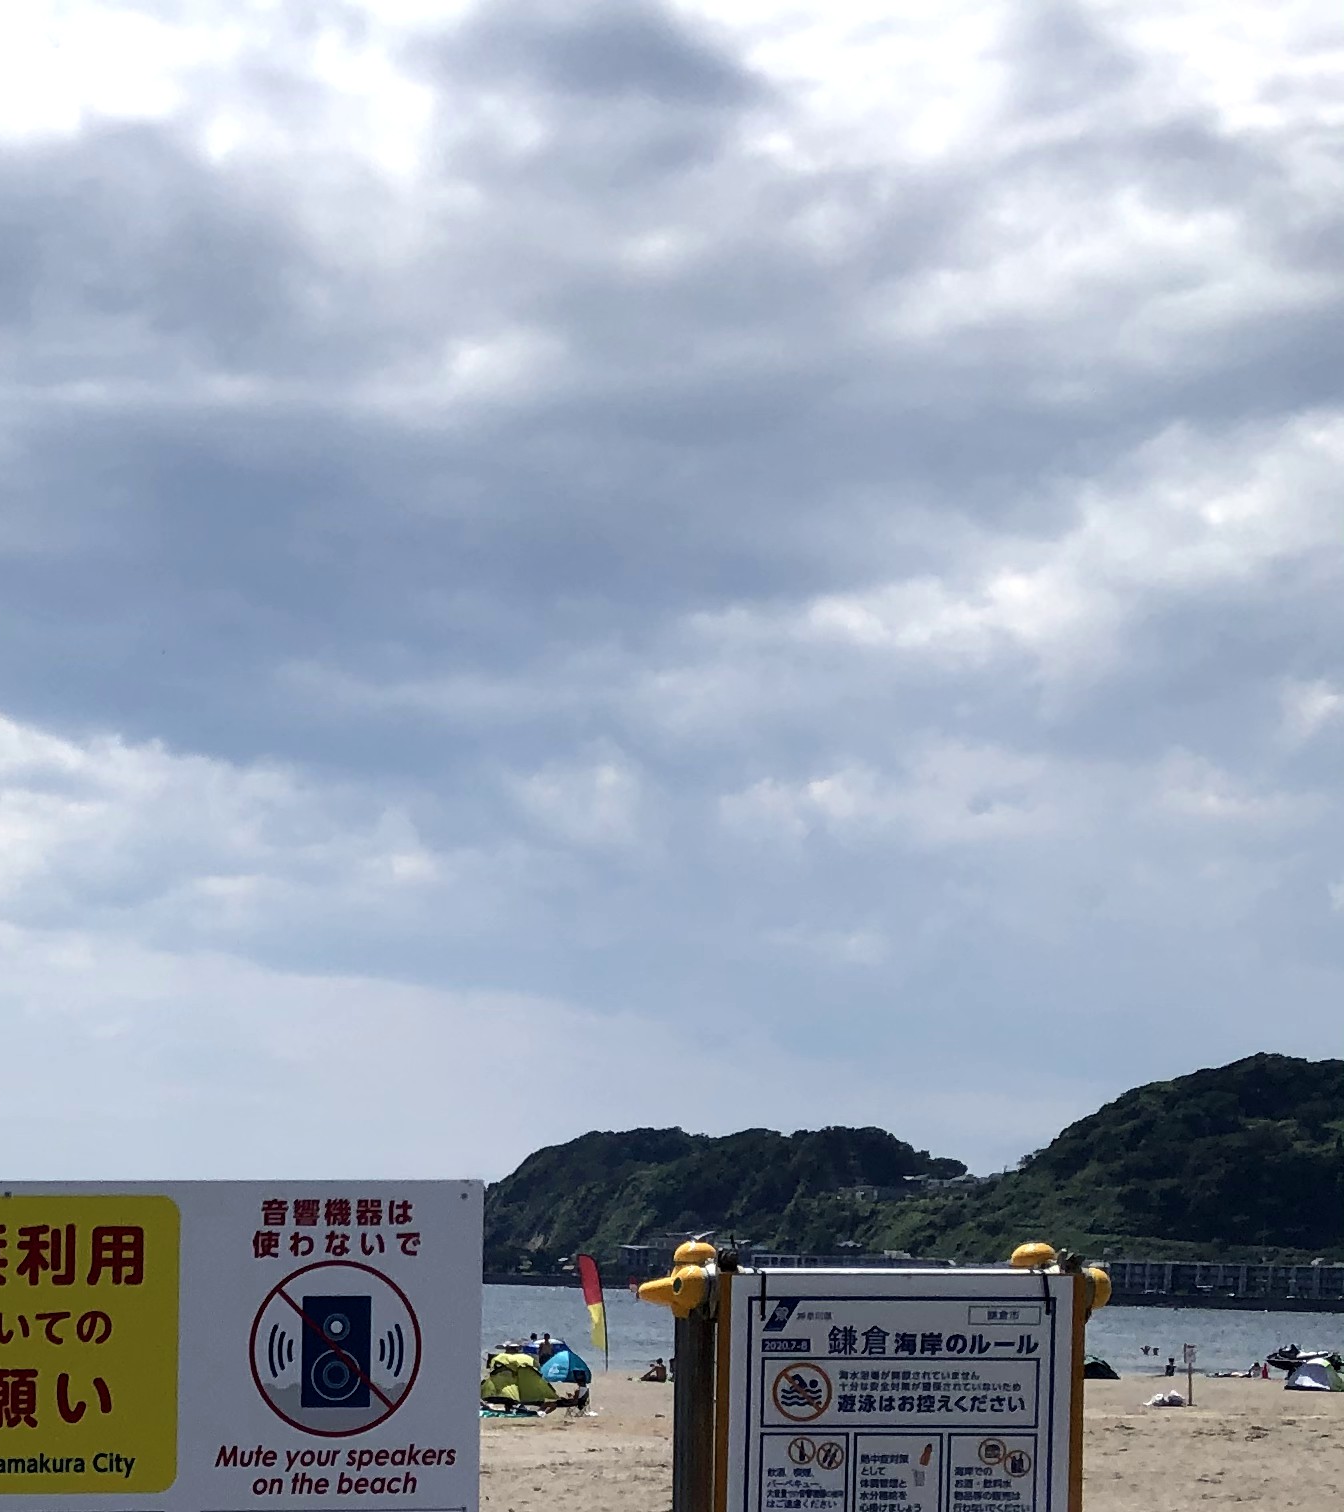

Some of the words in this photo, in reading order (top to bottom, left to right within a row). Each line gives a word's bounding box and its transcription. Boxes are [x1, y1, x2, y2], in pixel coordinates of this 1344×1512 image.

[261, 1199, 413, 1227] 音響機器は
[252, 1230, 422, 1259] 使わないで
[763, 1340, 809, 1352] 2020.7-8
[828, 1325, 1040, 1356] 鎌倉海岸のルール
[837, 1394, 1026, 1414] 遊泳はお控えください
[92, 1451, 136, 1479] City
[214, 1444, 278, 1469] Mute
[285, 1448, 342, 1474] your
[345, 1444, 457, 1472] speakers
[251, 1476, 285, 1496] on
[291, 1473, 334, 1496] the
[338, 1472, 418, 1496] beach
